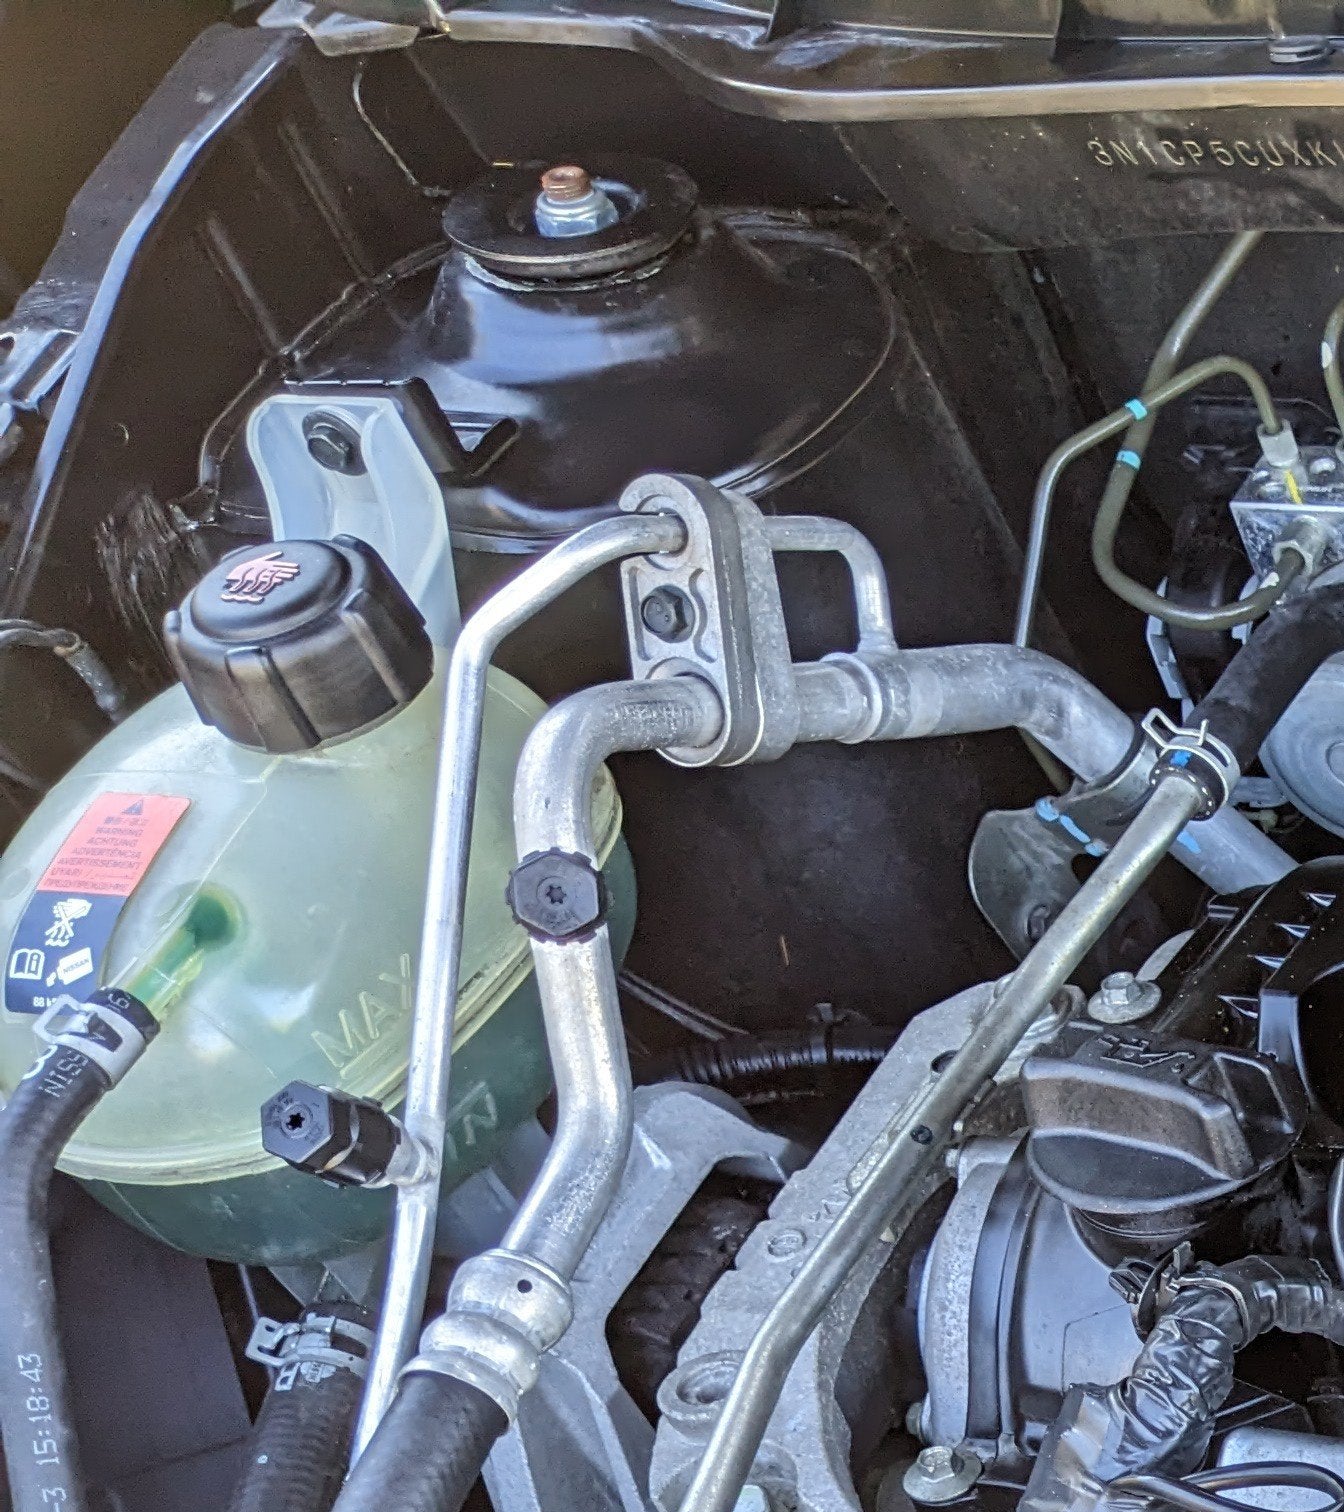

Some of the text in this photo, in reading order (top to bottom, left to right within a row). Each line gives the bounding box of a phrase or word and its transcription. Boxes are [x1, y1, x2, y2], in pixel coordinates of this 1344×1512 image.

[87, 837, 138, 847] ACHTUNG
[95, 827, 144, 837] WARNING
[311, 952, 412, 1068] MAX
[17, 1353, 61, 1466] 15:18:43
